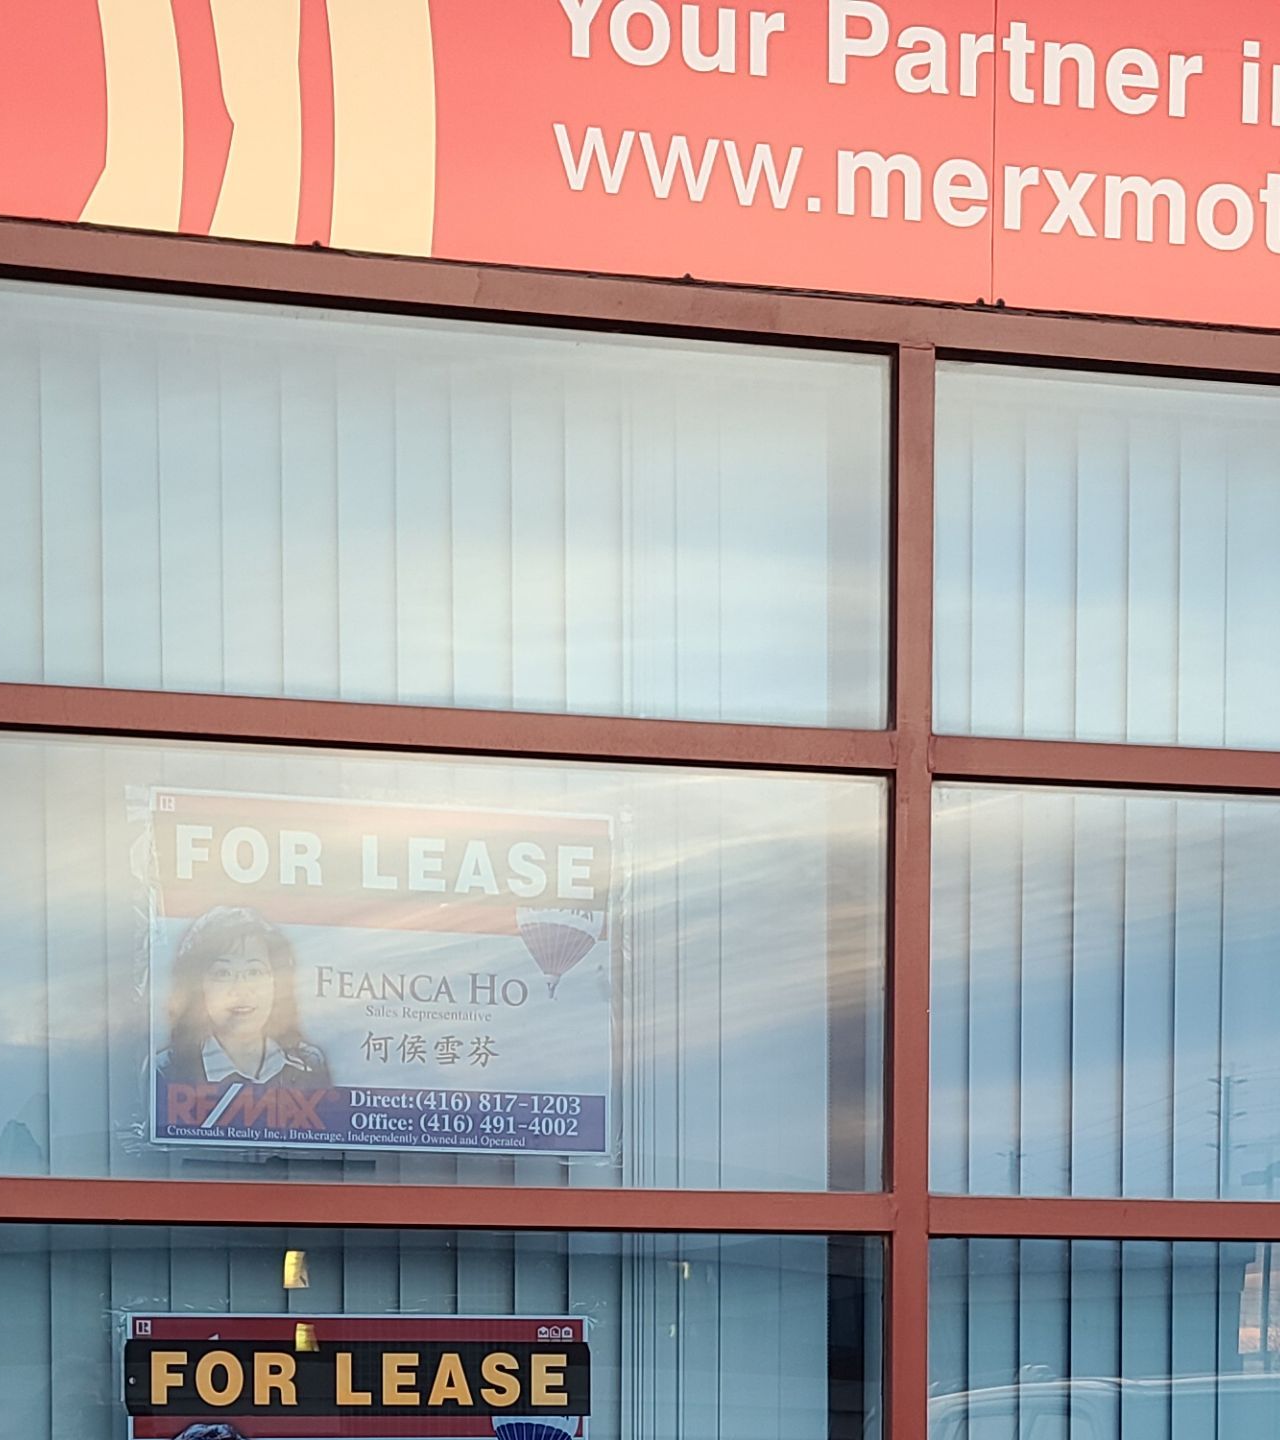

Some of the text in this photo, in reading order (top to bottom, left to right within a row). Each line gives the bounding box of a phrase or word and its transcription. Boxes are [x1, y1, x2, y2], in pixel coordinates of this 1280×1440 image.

[560, 0, 786, 77] Your
[827, 0, 1203, 119] Partner
[175, 824, 596, 901] FOR LEASE
[315, 965, 457, 1004] FEANCA
[366, 1004, 493, 1023] Sales Representative
[360, 1031, 501, 1068] 何侯雪芬
[478, 1094, 582, 1116] 817-1203
[167, 1125, 225, 1138] Crossroads
[227, 1127, 260, 1140] Realty
[347, 1132, 418, 1145] Independently
[421, 1134, 458, 1146] Owned
[459, 1135, 478, 1146] and
[480, 1136, 526, 1148] Operated
[350, 1112, 579, 1136] Office: (416) 491-4002
[150, 1349, 569, 1407] FOR LEASE
